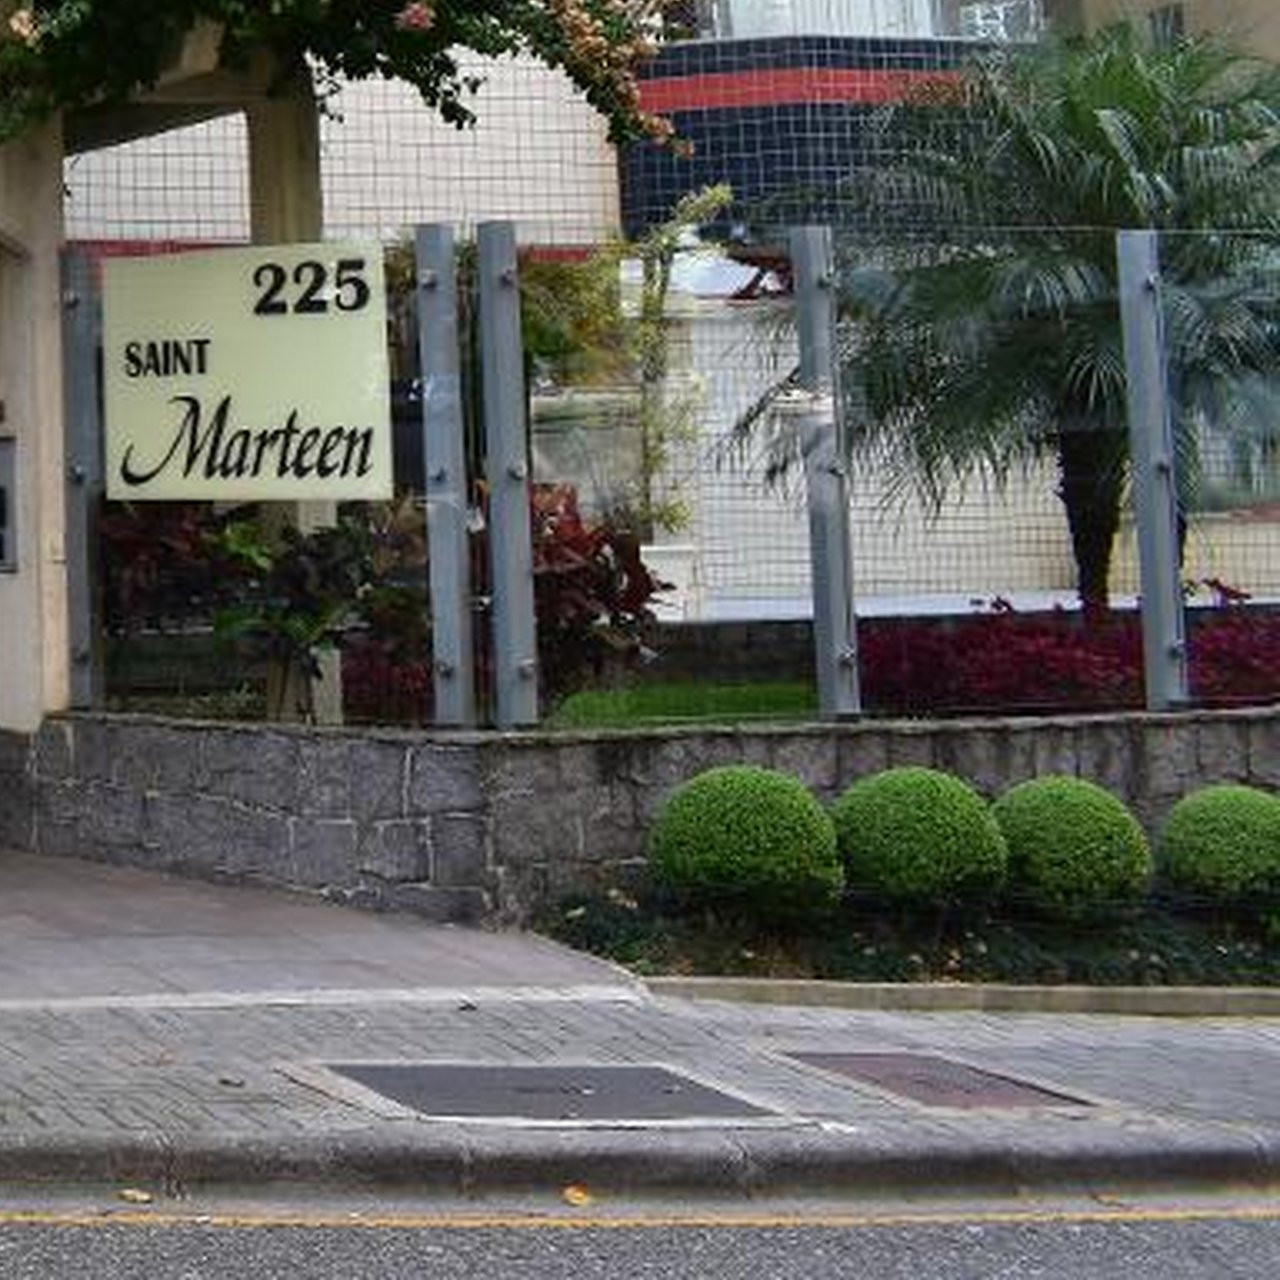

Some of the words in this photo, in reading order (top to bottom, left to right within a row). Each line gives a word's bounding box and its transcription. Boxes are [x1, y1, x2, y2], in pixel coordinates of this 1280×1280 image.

[252, 259, 370, 315] 225
[124, 338, 211, 377] SAINT
[120, 394, 374, 486] Marteen
